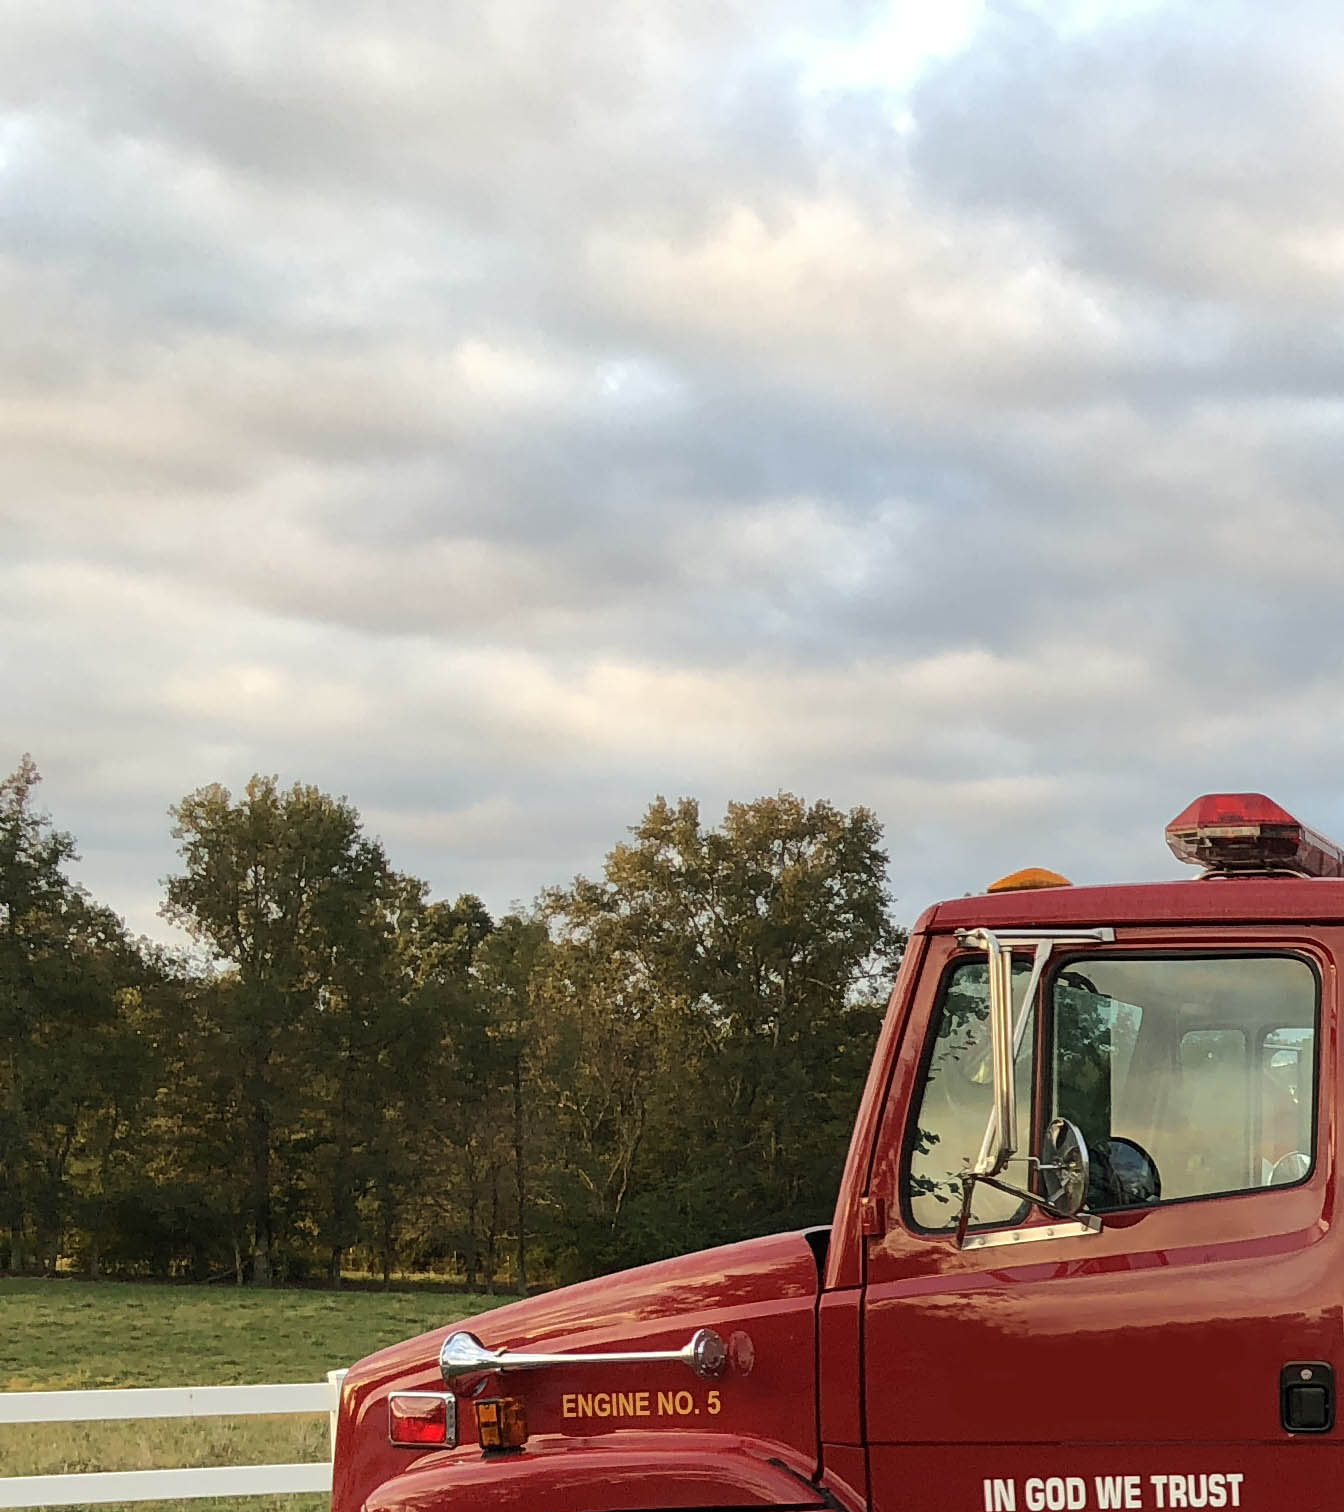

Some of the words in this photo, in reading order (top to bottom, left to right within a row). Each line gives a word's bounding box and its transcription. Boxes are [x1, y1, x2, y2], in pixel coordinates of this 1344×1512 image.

[562, 1392, 650, 1418] ENGINE
[657, 1390, 700, 1416] NO.
[707, 1390, 721, 1415] 5
[983, 1479, 1016, 1512] IN
[1025, 1477, 1086, 1511] GOD
[1095, 1475, 1142, 1509] WE
[1150, 1473, 1243, 1508] TRUST
